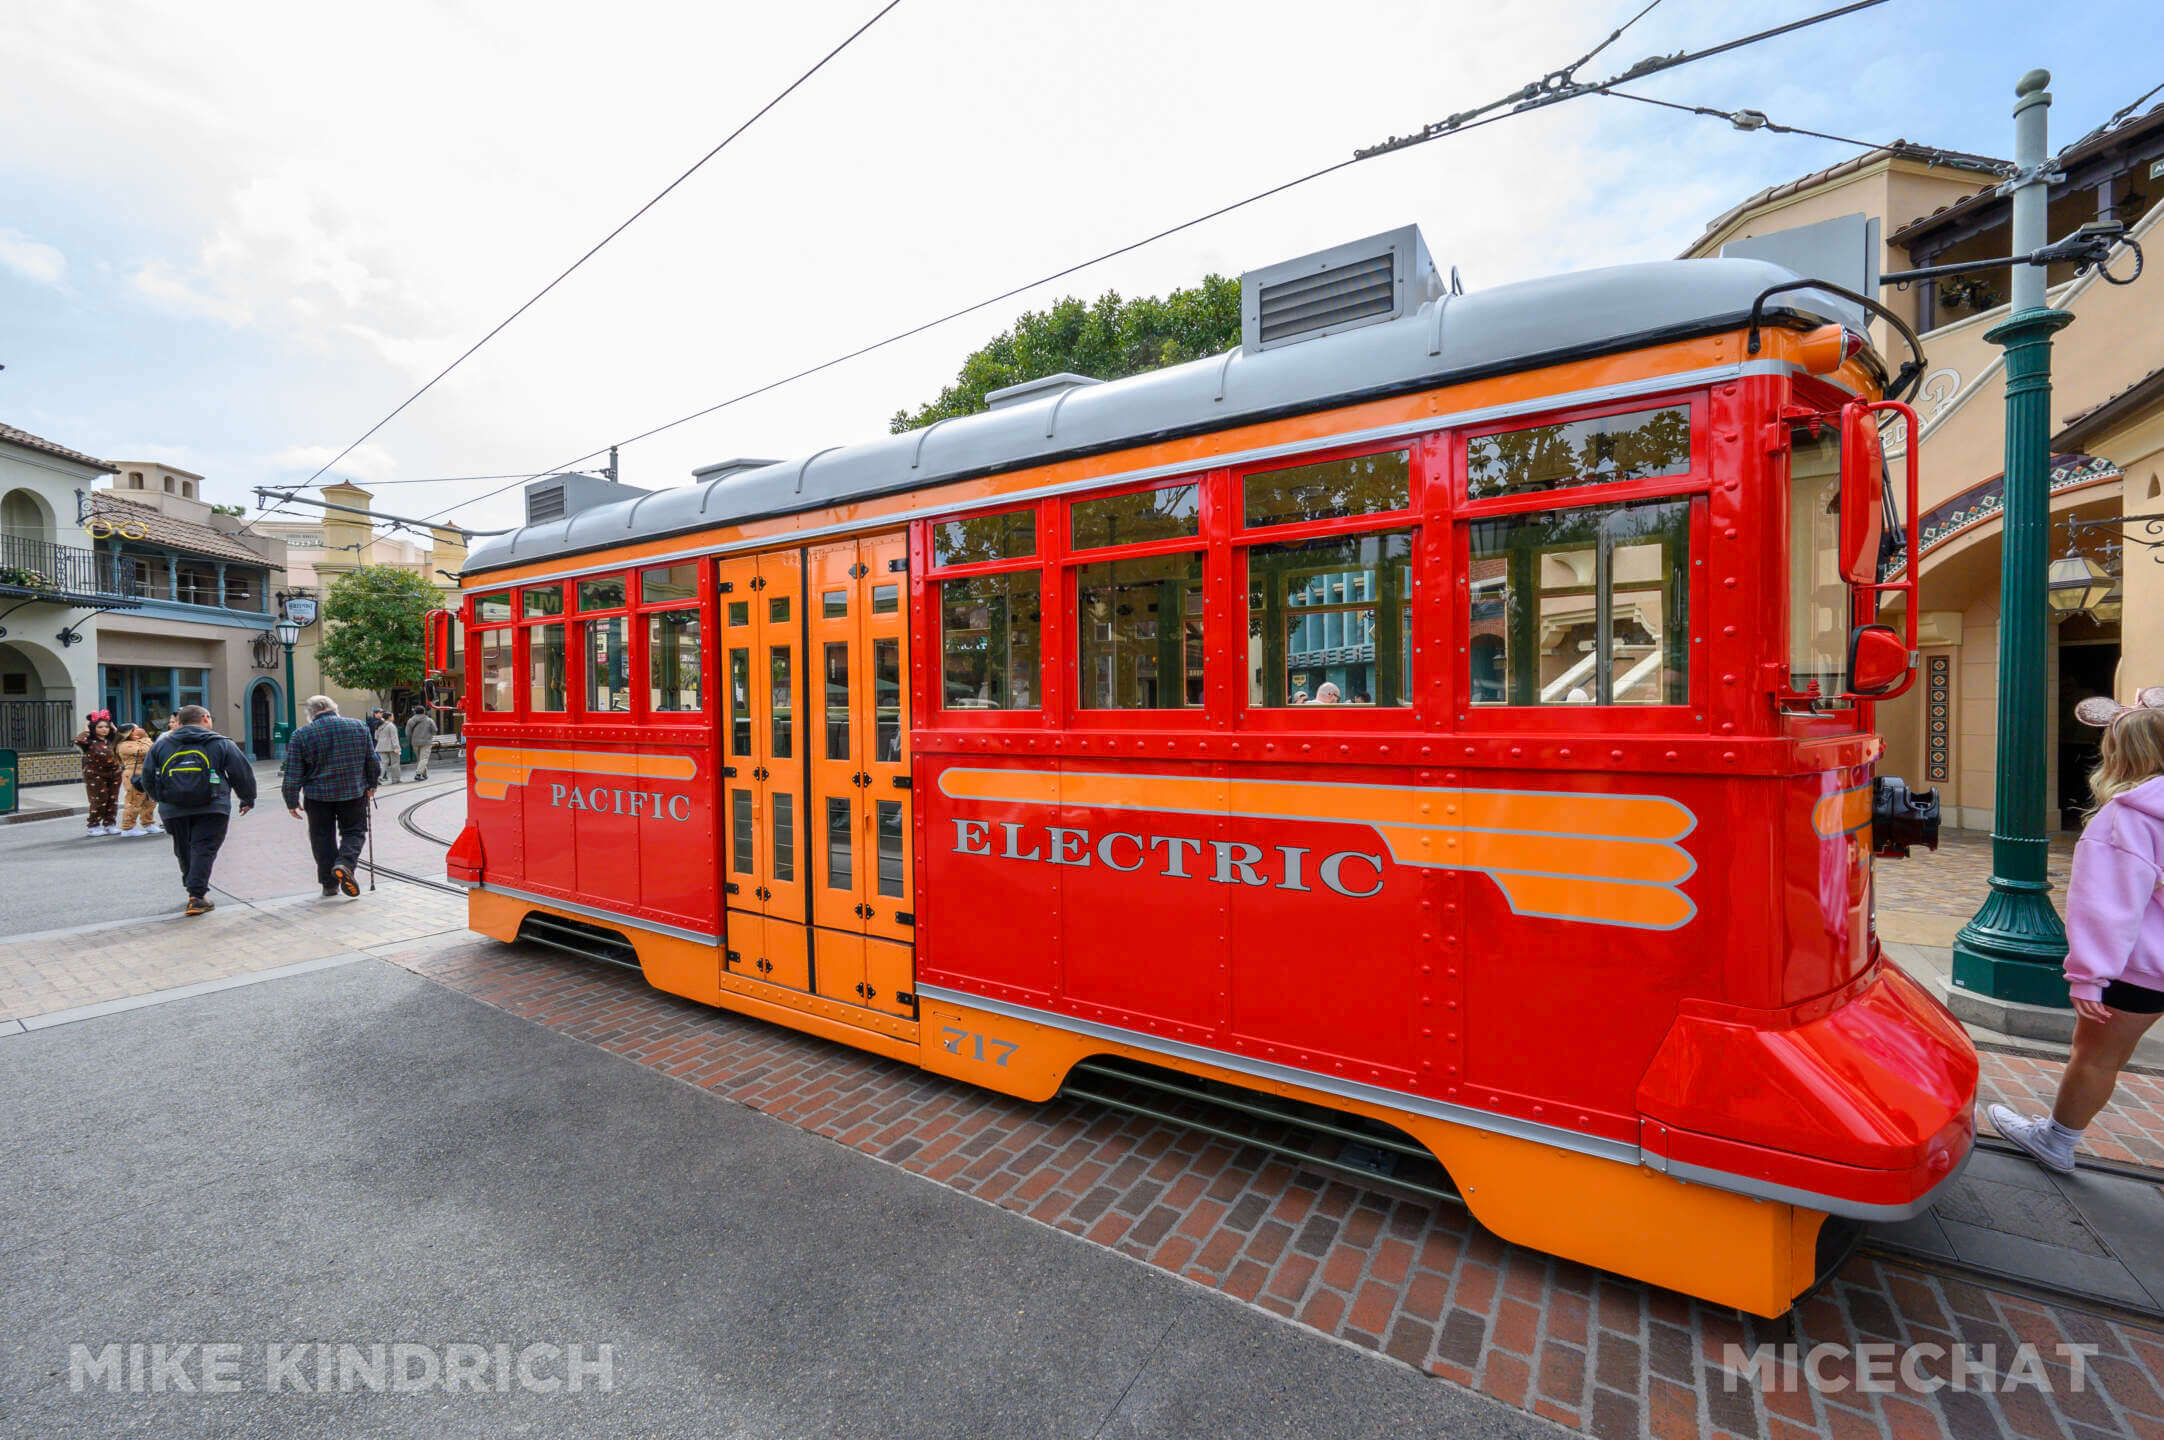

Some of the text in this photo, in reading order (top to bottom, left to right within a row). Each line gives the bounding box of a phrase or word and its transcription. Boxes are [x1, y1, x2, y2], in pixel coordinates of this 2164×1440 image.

[549, 783, 1385, 898] PACIFIC ELECTRIC
[941, 1026, 1020, 1067] 717
